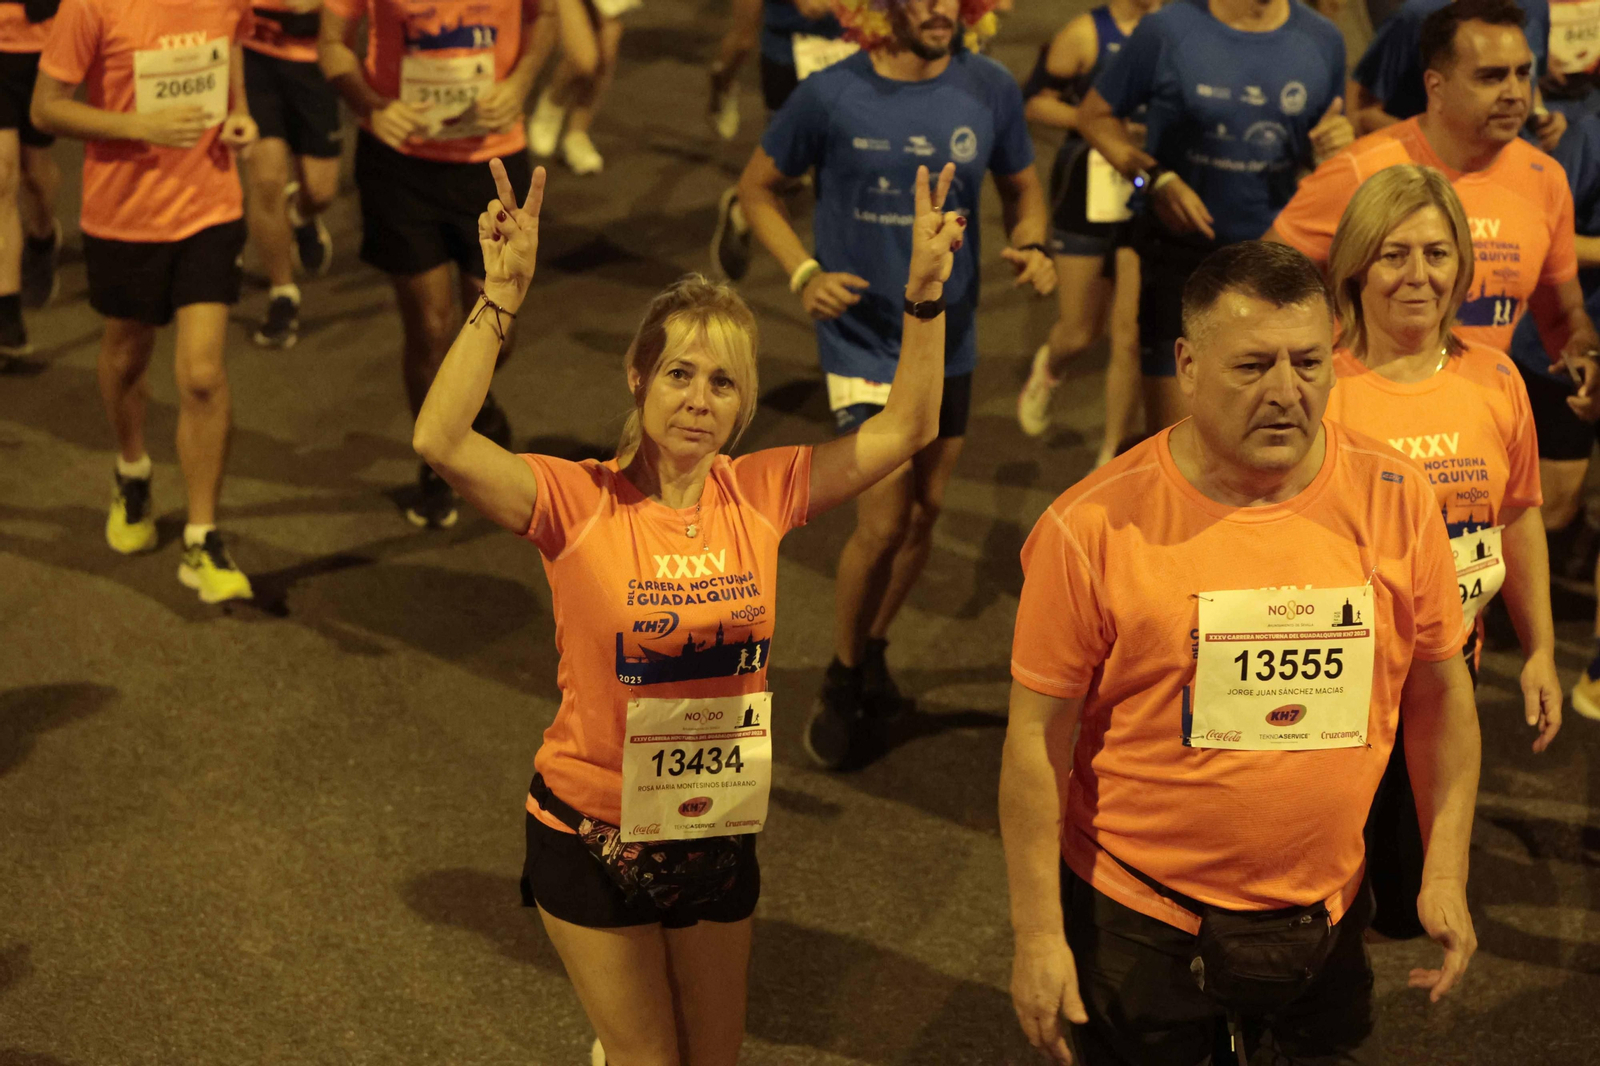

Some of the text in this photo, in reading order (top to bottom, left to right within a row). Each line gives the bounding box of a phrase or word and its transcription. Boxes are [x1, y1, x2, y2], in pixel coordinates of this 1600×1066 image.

[1424, 458, 1486, 470] NOCTURNA
[653, 548, 726, 579] XXXV
[628, 571, 754, 592] CARRERA NOCTURNA
[637, 583, 760, 606] GUADALQUIVIR
[1234, 648, 1344, 681] 13555
[618, 674, 642, 684] 2023
[1278, 687, 1313, 695] SÁNCHEZ
[1321, 731, 1360, 740] Cruzcampo
[652, 745, 744, 777] 13434
